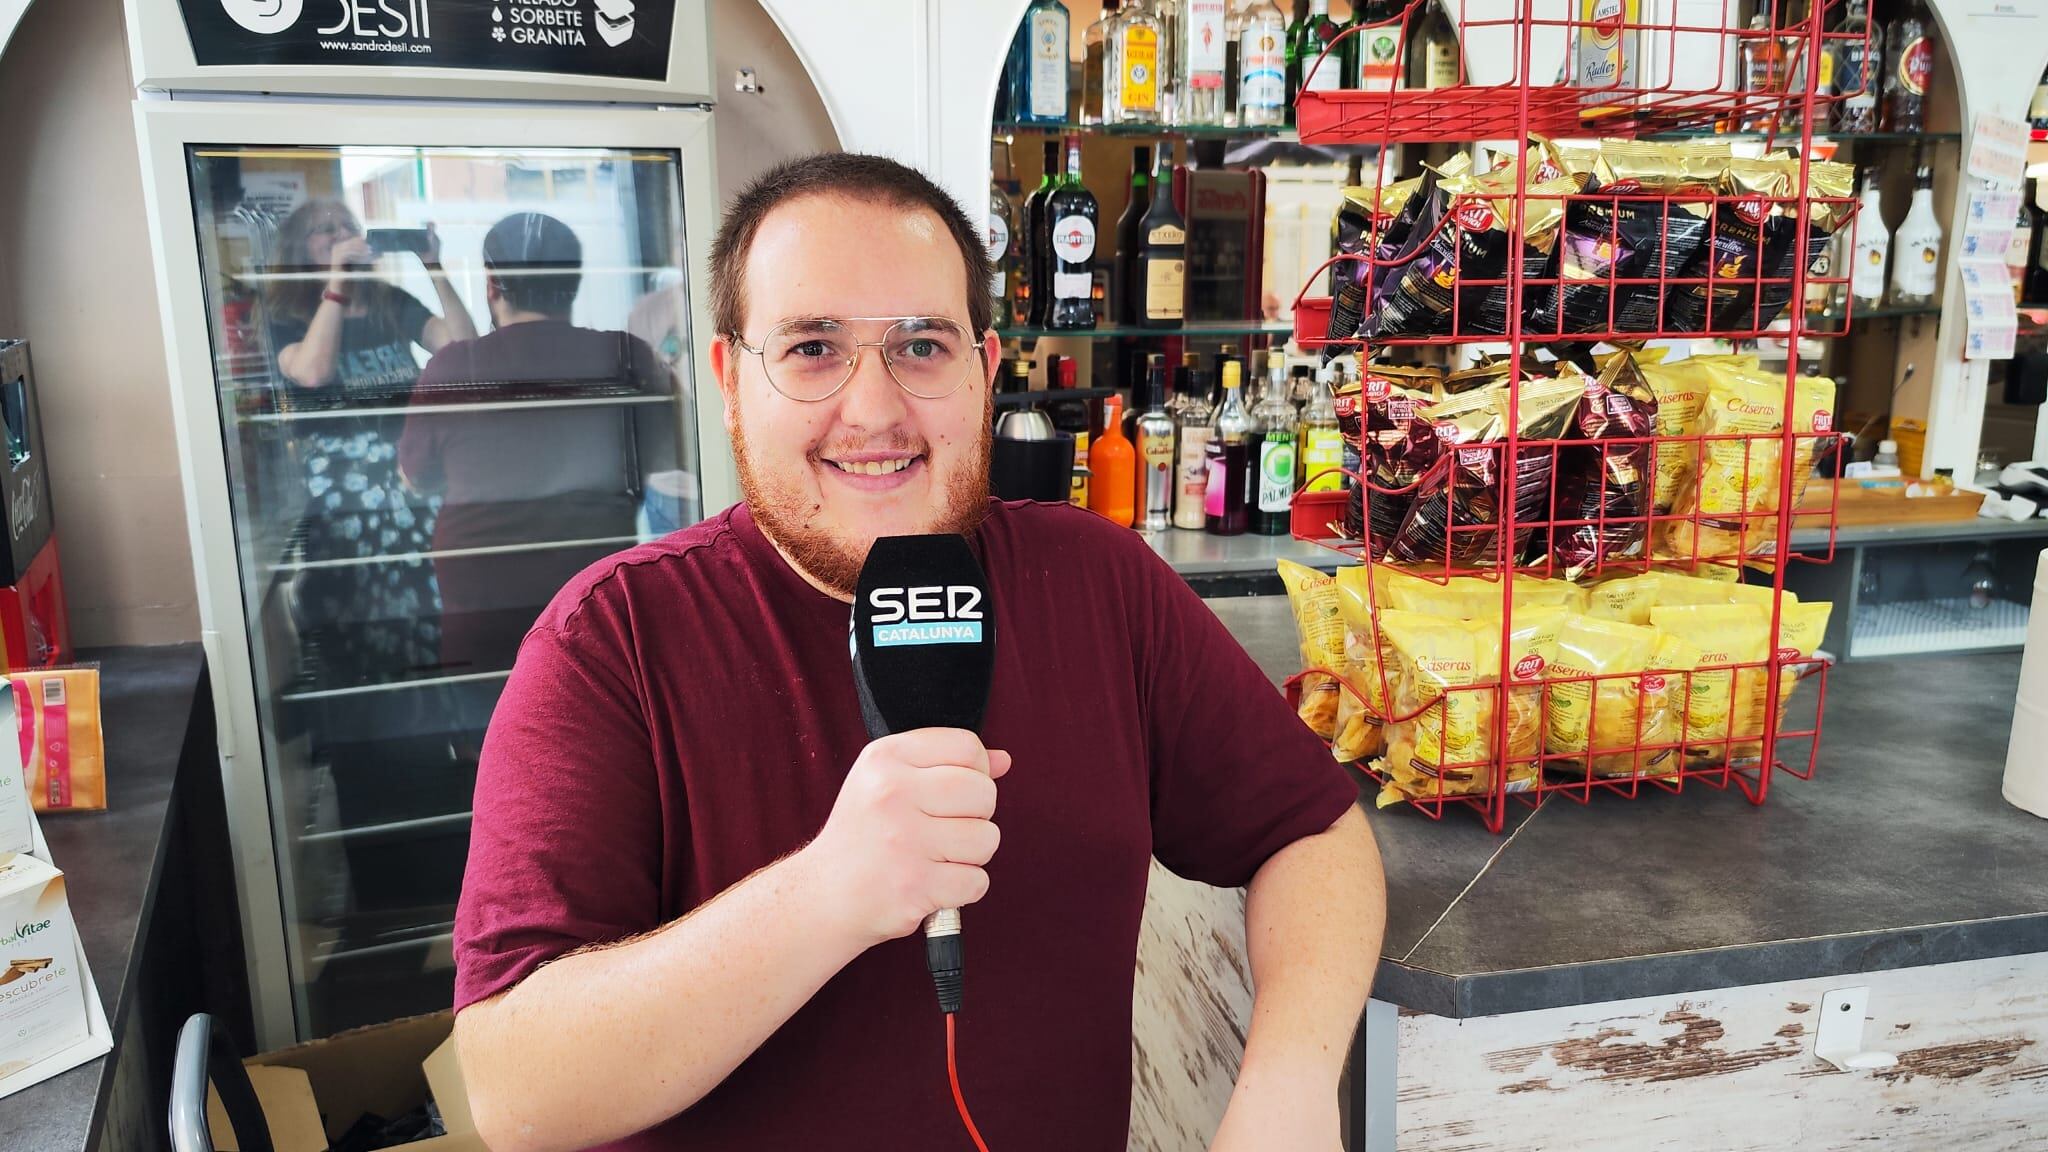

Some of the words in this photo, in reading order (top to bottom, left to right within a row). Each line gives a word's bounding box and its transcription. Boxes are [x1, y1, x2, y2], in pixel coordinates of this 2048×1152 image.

[510, 8, 583, 27] SORBETE
[1598, 5, 1618, 16] AMSTEL
[511, 27, 586, 46] GRANITA
[320, 40, 432, 54] www.sandrodesii.com
[1586, 60, 1615, 83] Radler
[1726, 397, 1776, 416] Caseras
[869, 585, 984, 623] SER
[878, 626, 975, 642] CATALUNYA
[1416, 655, 1472, 673] Caseras
[1517, 658, 1541, 672] FRIT
